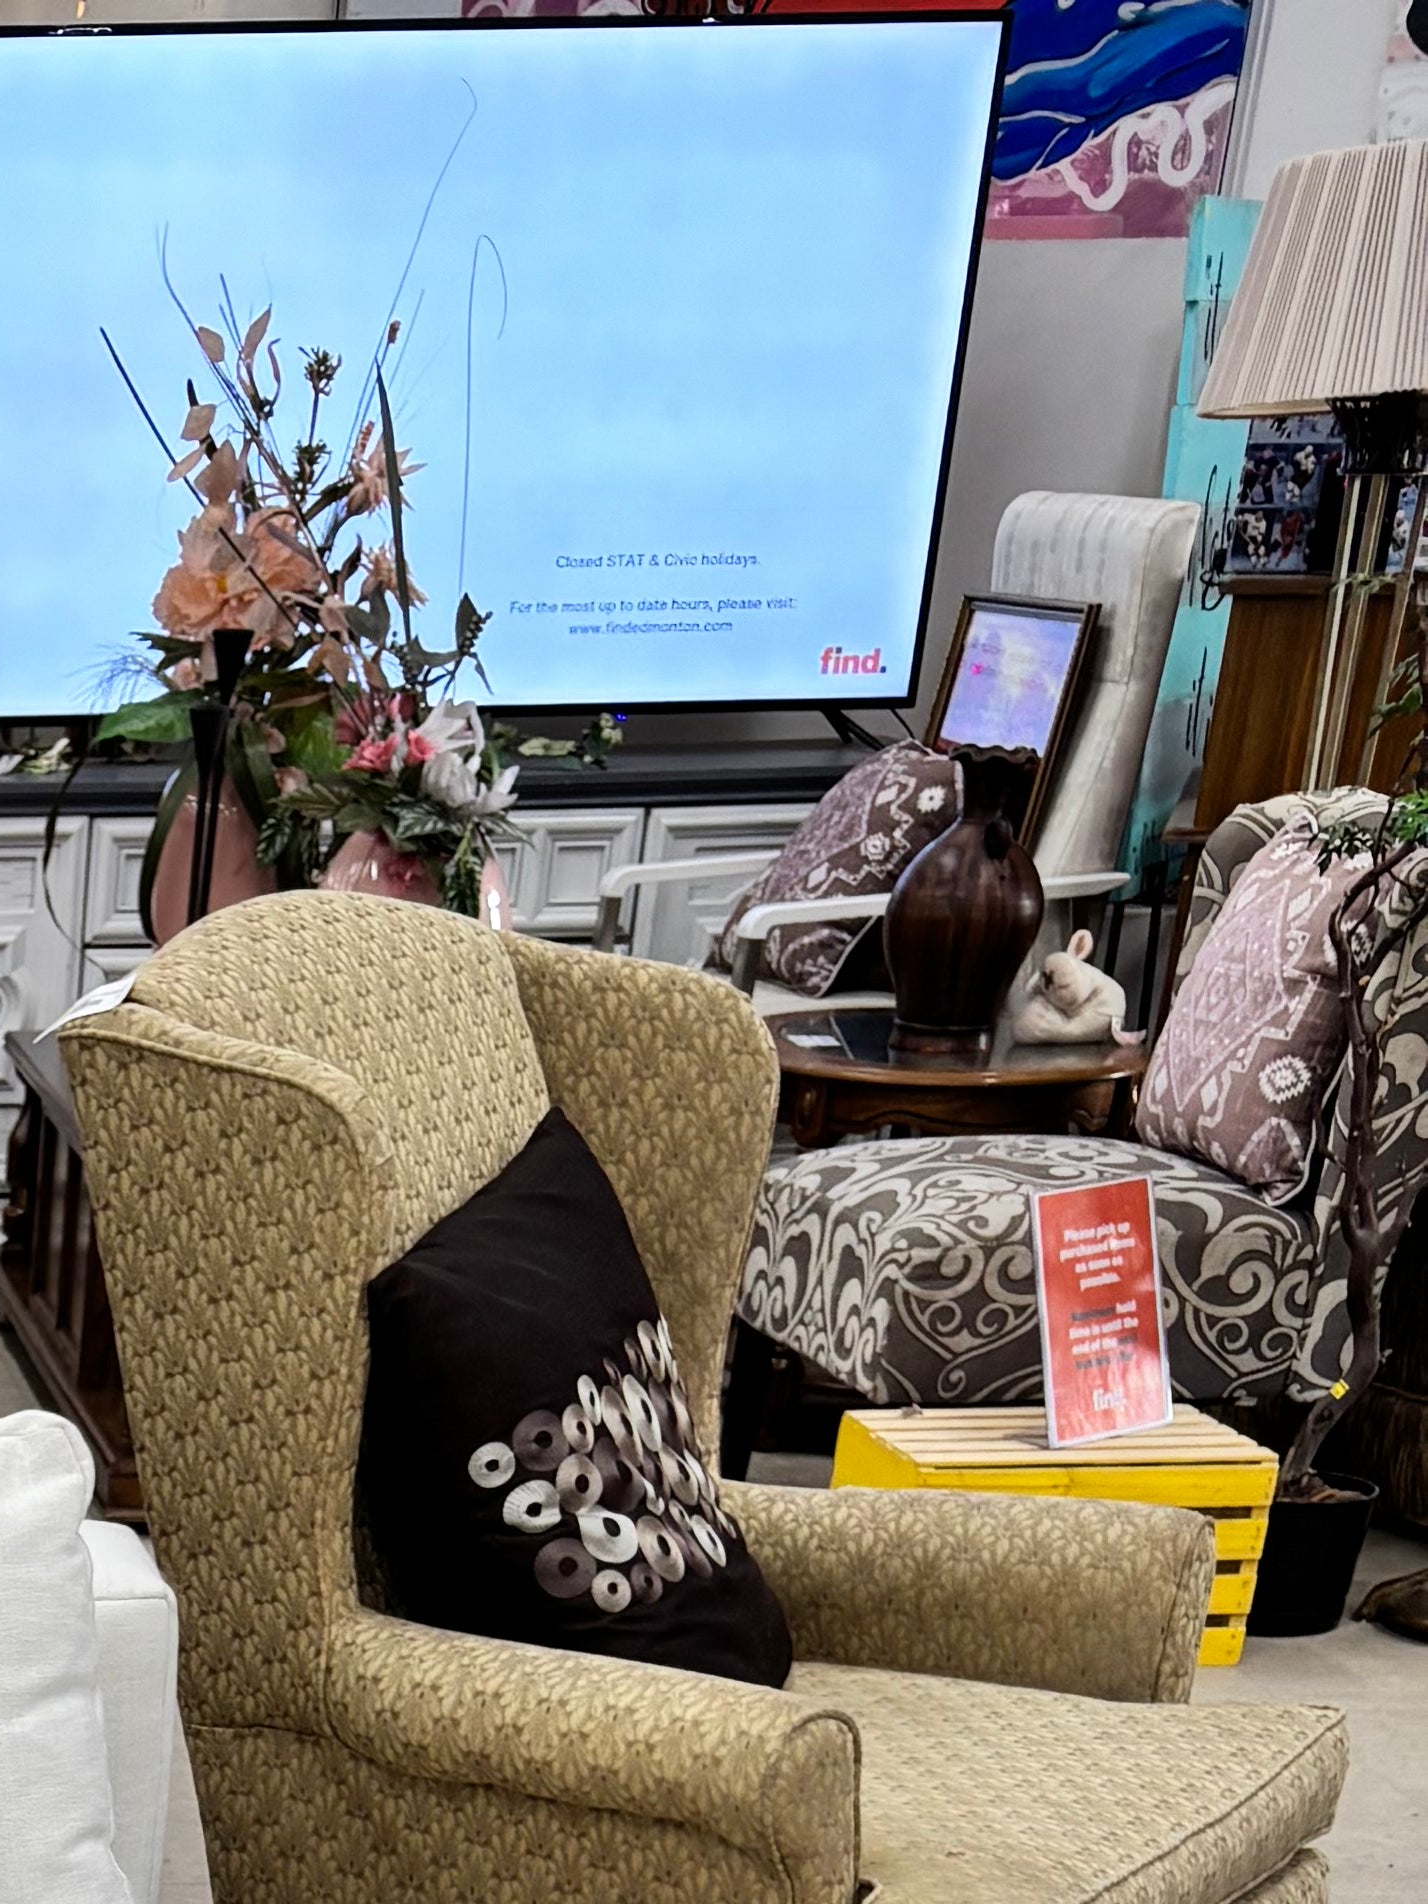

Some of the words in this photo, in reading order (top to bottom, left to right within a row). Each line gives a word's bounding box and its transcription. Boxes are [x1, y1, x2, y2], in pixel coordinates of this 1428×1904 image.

[555, 555, 603, 568] Closed
[606, 554, 645, 567] STAT
[648, 554, 660, 567] &
[664, 553, 697, 566] Civic
[701, 553, 761, 568] holidays.
[509, 601, 533, 614] For
[536, 602, 558, 613] the
[561, 601, 594, 612] most
[598, 602, 617, 615] up
[620, 600, 633, 611] to
[637, 599, 668, 611] date
[672, 598, 713, 612] hours,
[717, 598, 762, 613] please
[569, 621, 733, 634] www.findedmonton.com
[820, 646, 887, 675] find.
[1063, 1227, 1096, 1242] Please
[1096, 1222, 1116, 1240] pick
[1117, 1221, 1131, 1235] up
[1059, 1240, 1109, 1263] purchased
